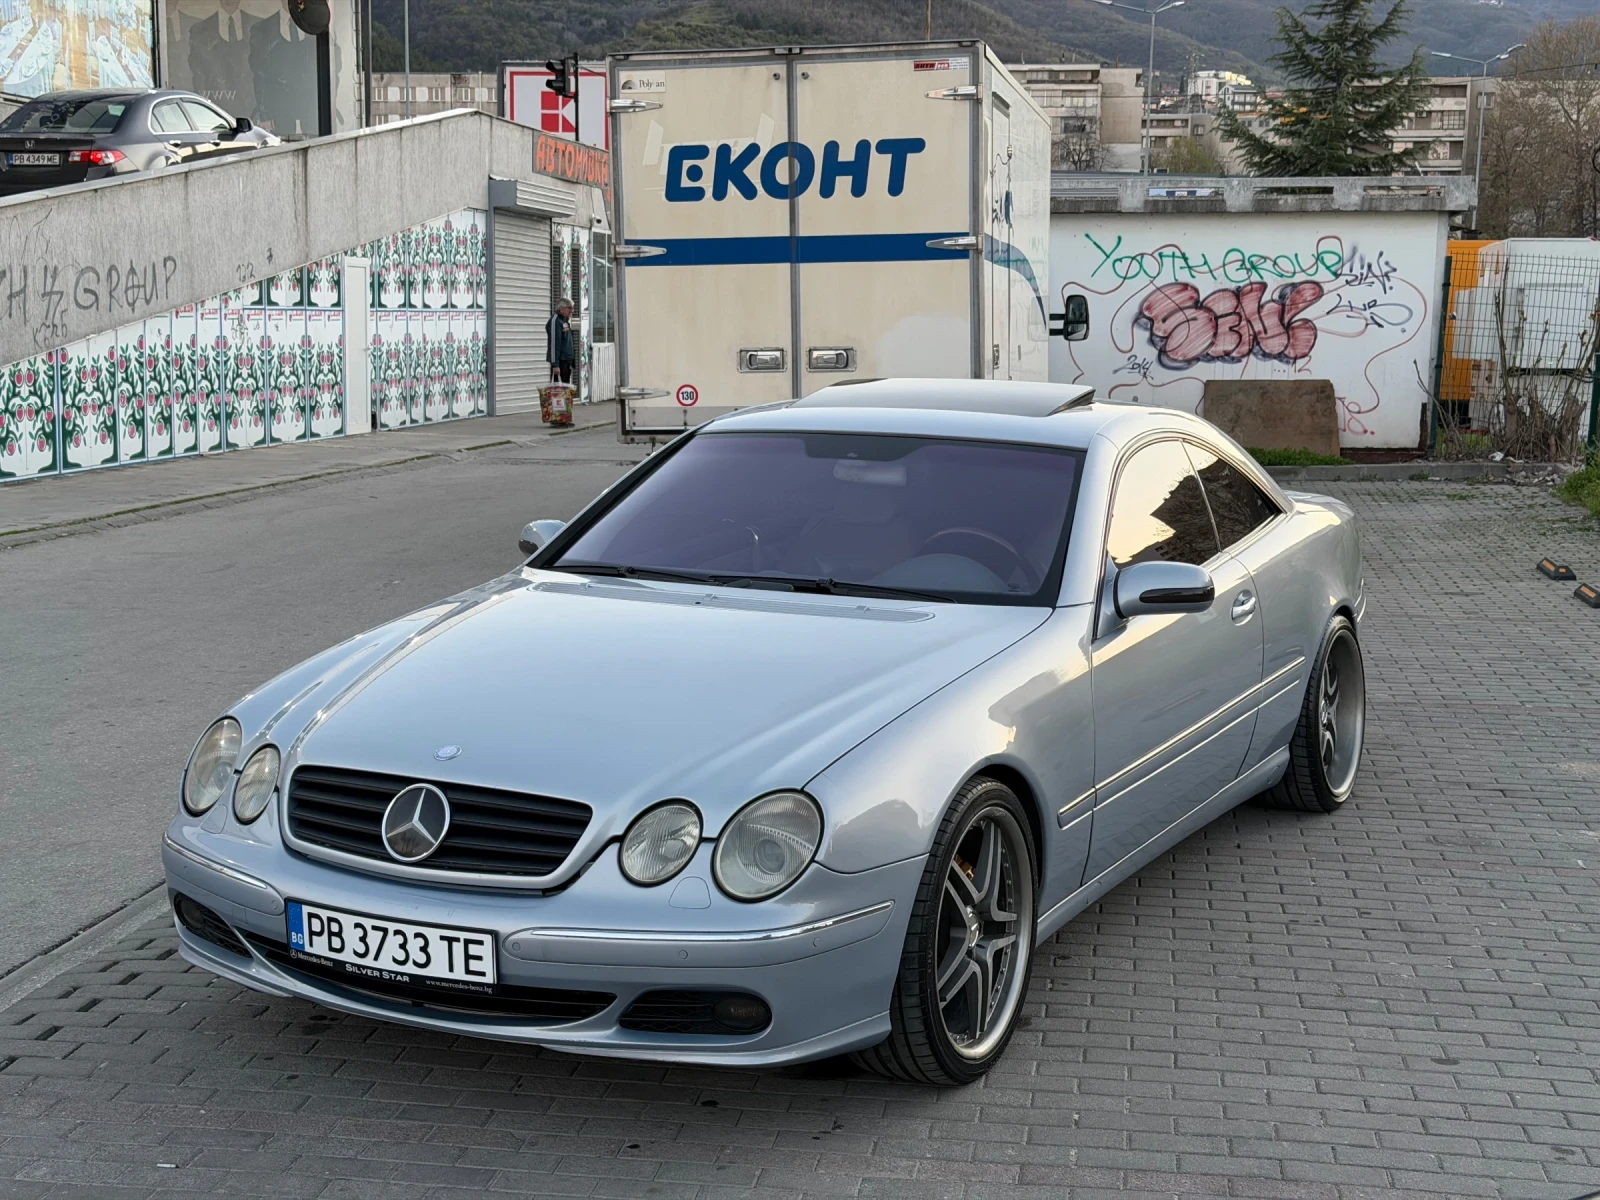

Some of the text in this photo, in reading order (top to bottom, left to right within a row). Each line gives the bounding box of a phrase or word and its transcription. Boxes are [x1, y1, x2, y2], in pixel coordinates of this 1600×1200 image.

[14, 155, 58, 164] PB 4349 ME
[536, 135, 609, 187] АВТОМИВКА
[665, 137, 926, 202] ЕКОНТ
[1085, 233, 1343, 284] YOUTH GROUP
[680, 390, 695, 401] 130
[291, 931, 304, 945] BG
[307, 911, 487, 978] PB 3733 TE
[297, 952, 333, 967] Mercedes-Benz
[426, 979, 493, 994] www.mercedes-benz.bg
